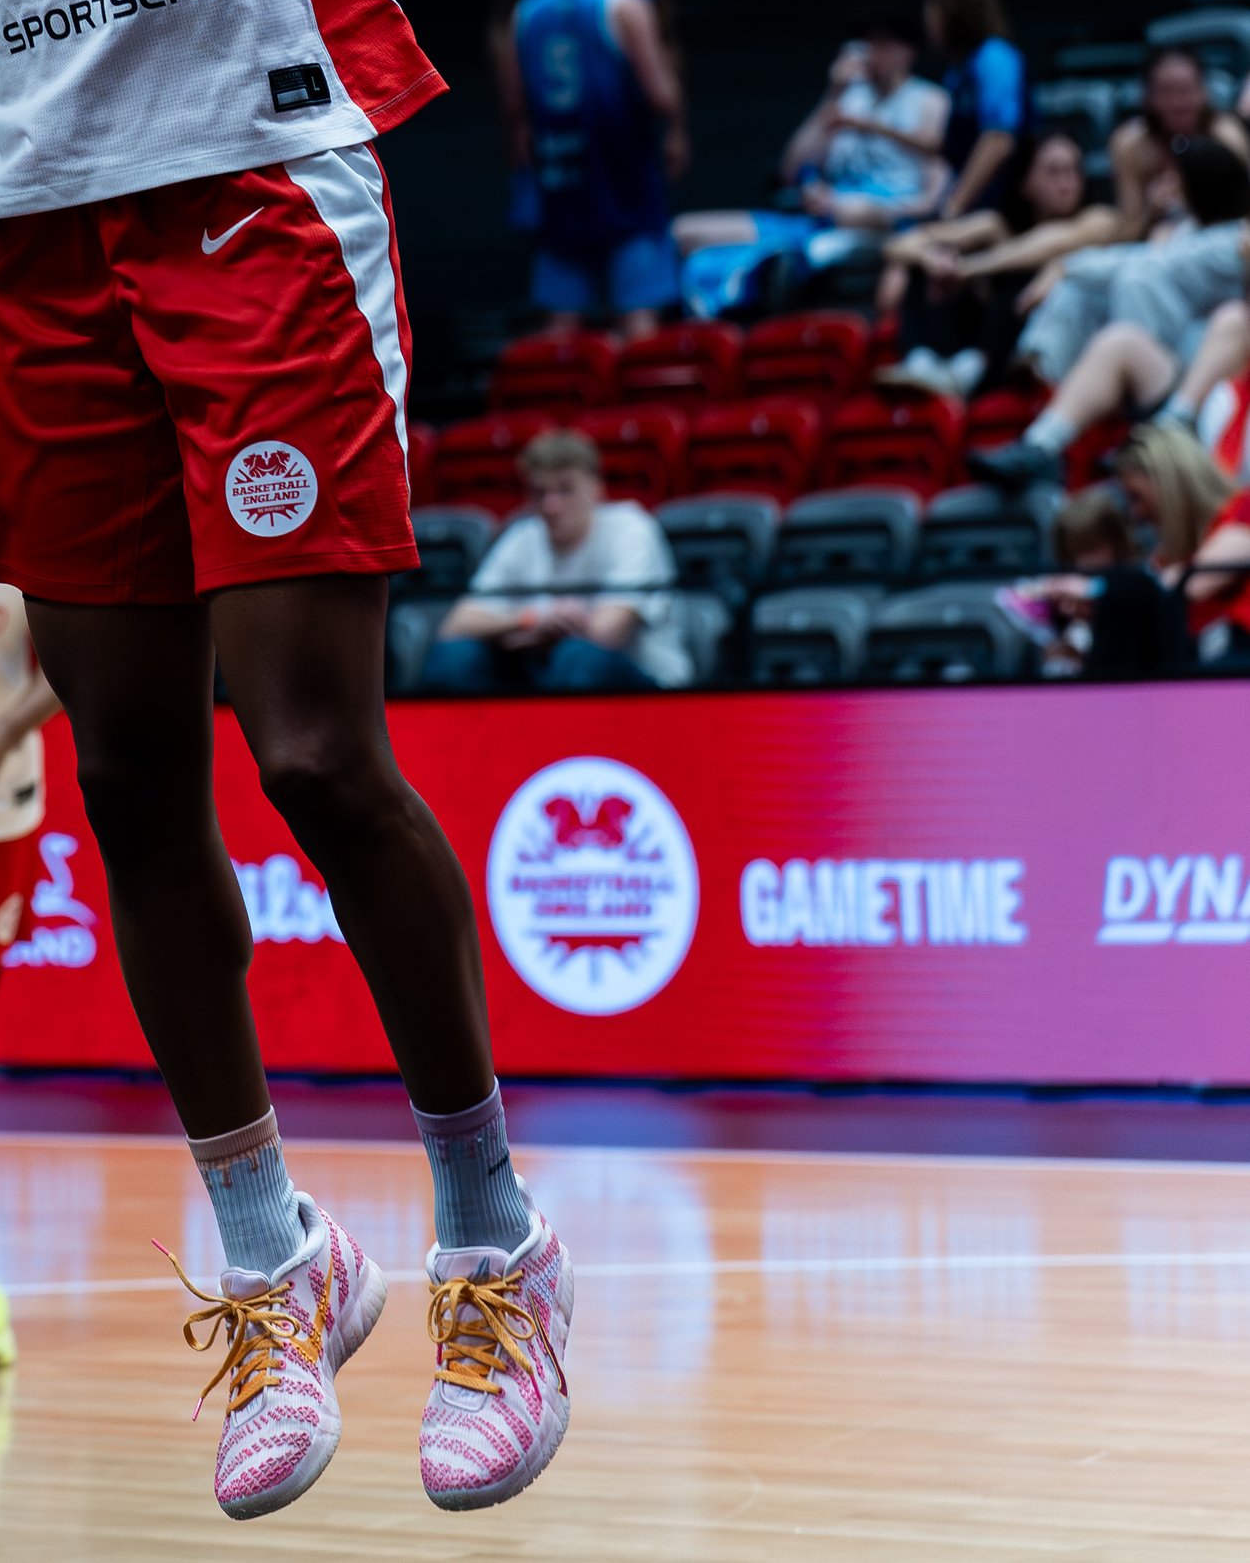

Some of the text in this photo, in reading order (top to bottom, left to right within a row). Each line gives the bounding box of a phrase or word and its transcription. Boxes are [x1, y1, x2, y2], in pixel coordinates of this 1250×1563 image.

[311, 76, 320, 91] L
[232, 479, 310, 497] BASKETBALL
[243, 490, 300, 505] ENGLAND
[740, 857, 1029, 947] GAMETIME
